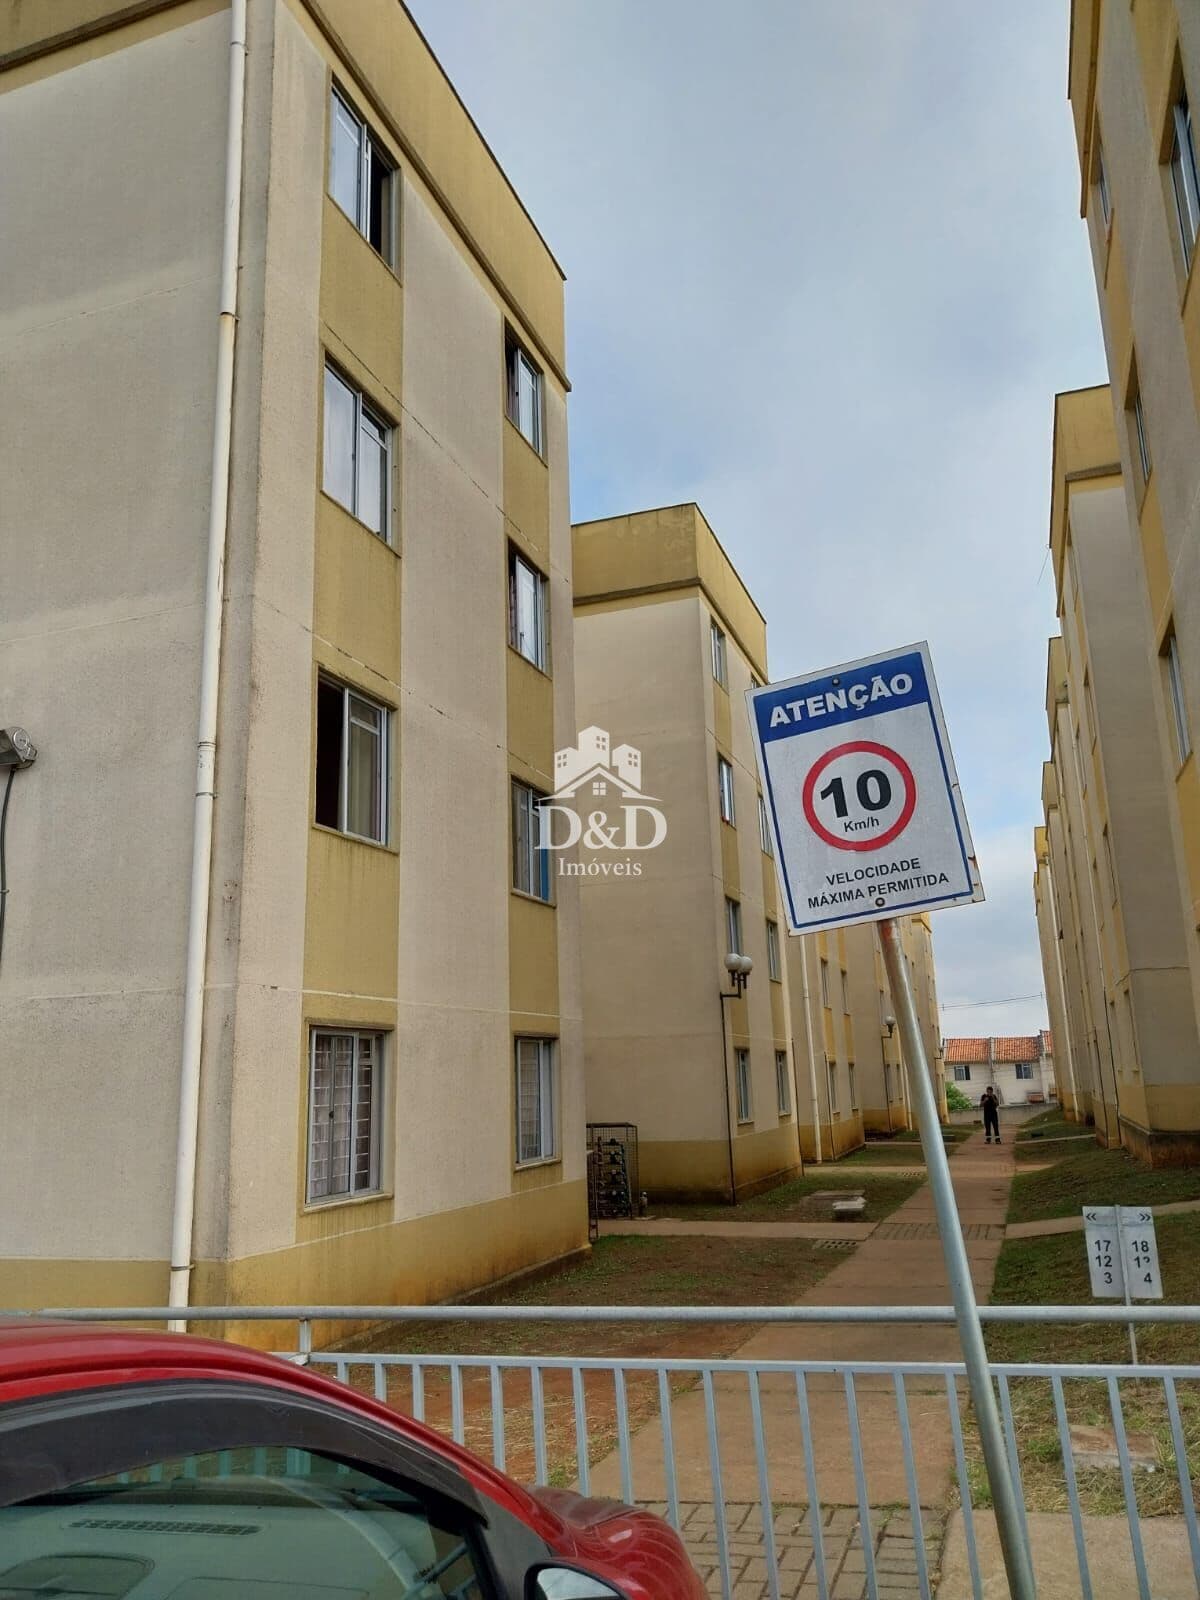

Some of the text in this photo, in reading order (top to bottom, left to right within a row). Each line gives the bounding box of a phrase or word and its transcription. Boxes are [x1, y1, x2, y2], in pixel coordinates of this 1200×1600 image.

[770, 673, 913, 728] ATENÇÃO
[820, 769, 892, 819] 10
[843, 816, 880, 833] Km/h
[825, 857, 921, 886] VELOCIDADE
[807, 872, 949, 909] MÁXIMA PERMITIDA
[1094, 1240, 1111, 1252] 17
[1131, 1240, 1149, 1252] 18
[1095, 1255, 1112, 1267] 12
[1103, 1272, 1113, 1284] 3
[1143, 1272, 1152, 1283] 4
